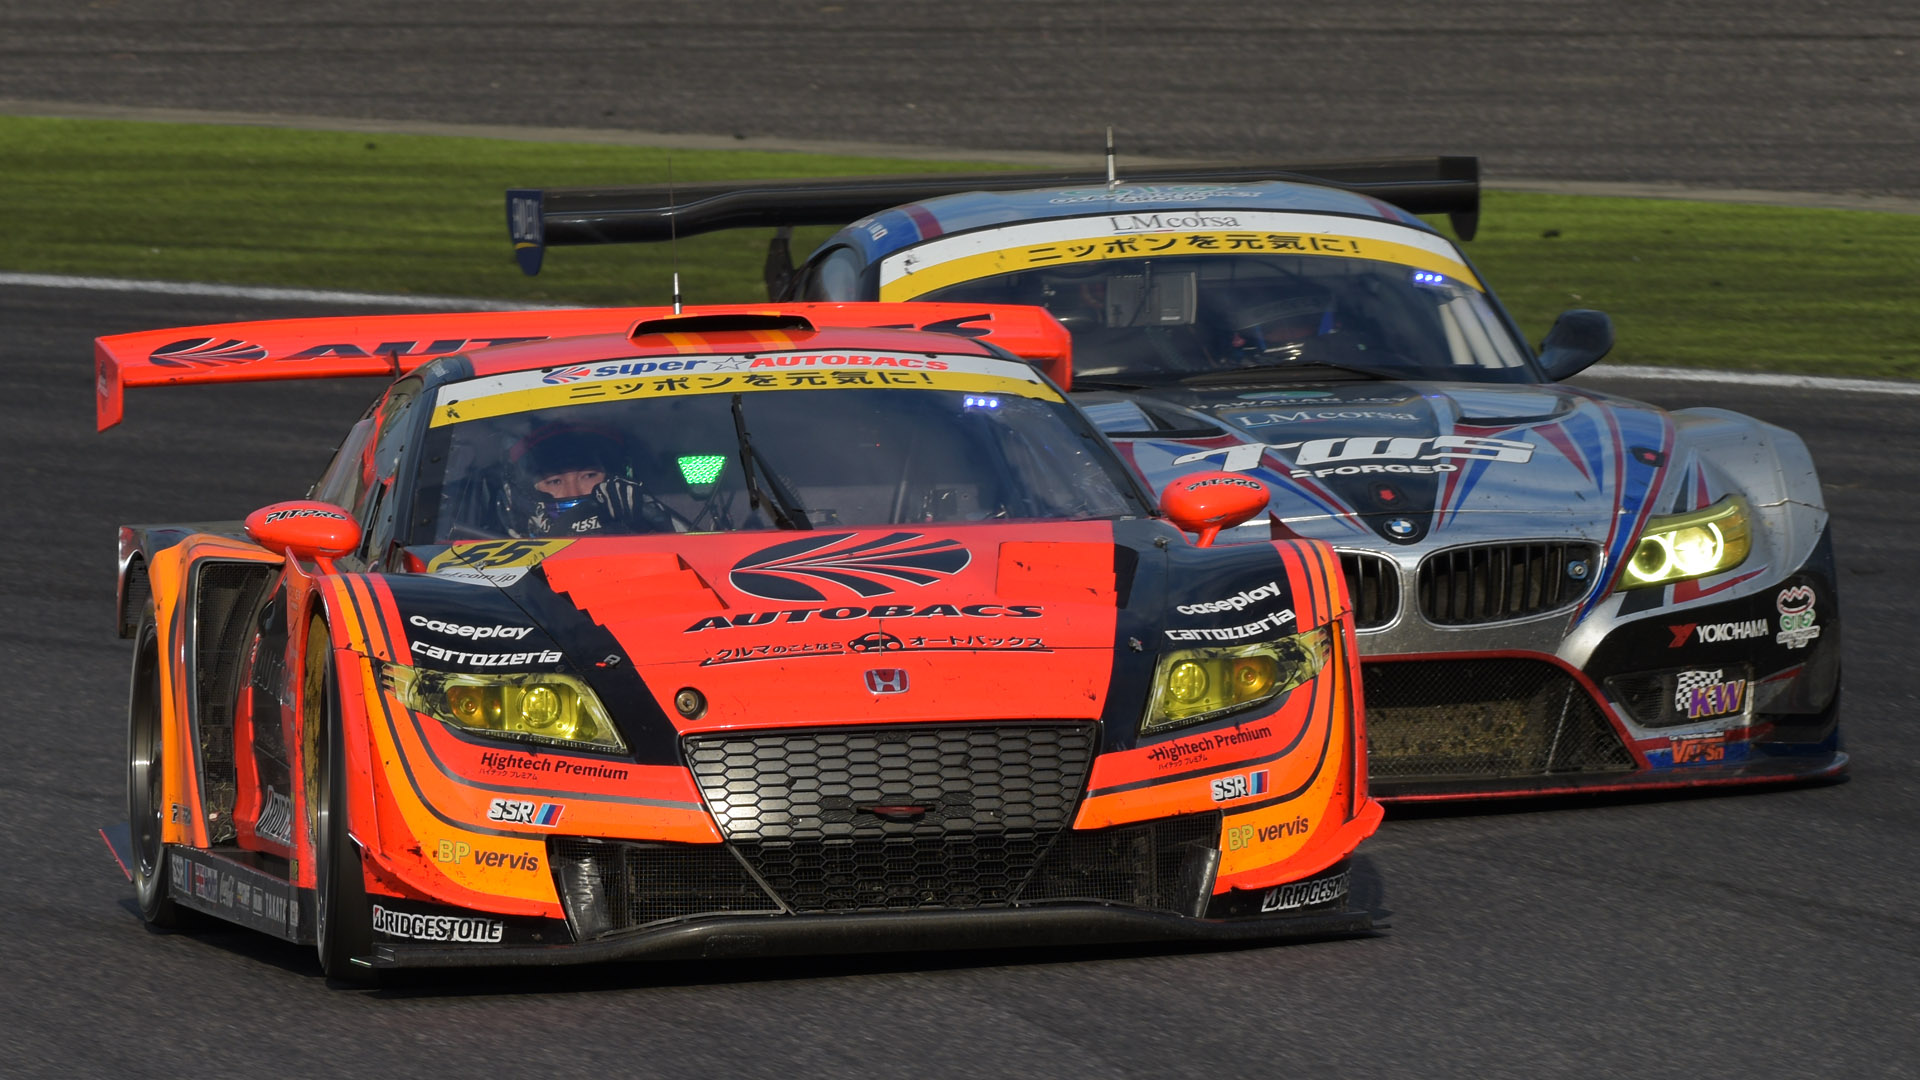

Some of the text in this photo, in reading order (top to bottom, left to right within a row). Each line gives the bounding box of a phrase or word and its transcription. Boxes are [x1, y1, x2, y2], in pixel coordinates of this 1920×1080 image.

[1028, 234, 1360, 262] ニッポンを元気に!
[594, 353, 948, 379] super AUTOBACS
[569, 372, 934, 399] ニッポンを元気に!
[264, 508, 347, 525] PIT-PRO
[436, 541, 552, 571] 55
[1177, 582, 1281, 615] caseplay
[410, 615, 534, 640] caseplay
[683, 603, 1044, 633] AUTOBACS
[1165, 609, 1296, 641] carrozzeria
[1696, 618, 1769, 643] YOKOHAMA
[411, 641, 563, 666] carrozzeria
[716, 634, 1048, 660] クルマのことなら オートバックス
[1688, 679, 1745, 718] KW
[1153, 725, 1272, 762] Hightech Premium
[481, 752, 628, 780] Hightech Premium
[1211, 776, 1248, 802] SSR
[487, 797, 536, 824] SSR
[1228, 816, 1309, 852] BP vervis
[438, 840, 540, 872] BP vervis
[373, 905, 503, 942] BRIDGESTONE
